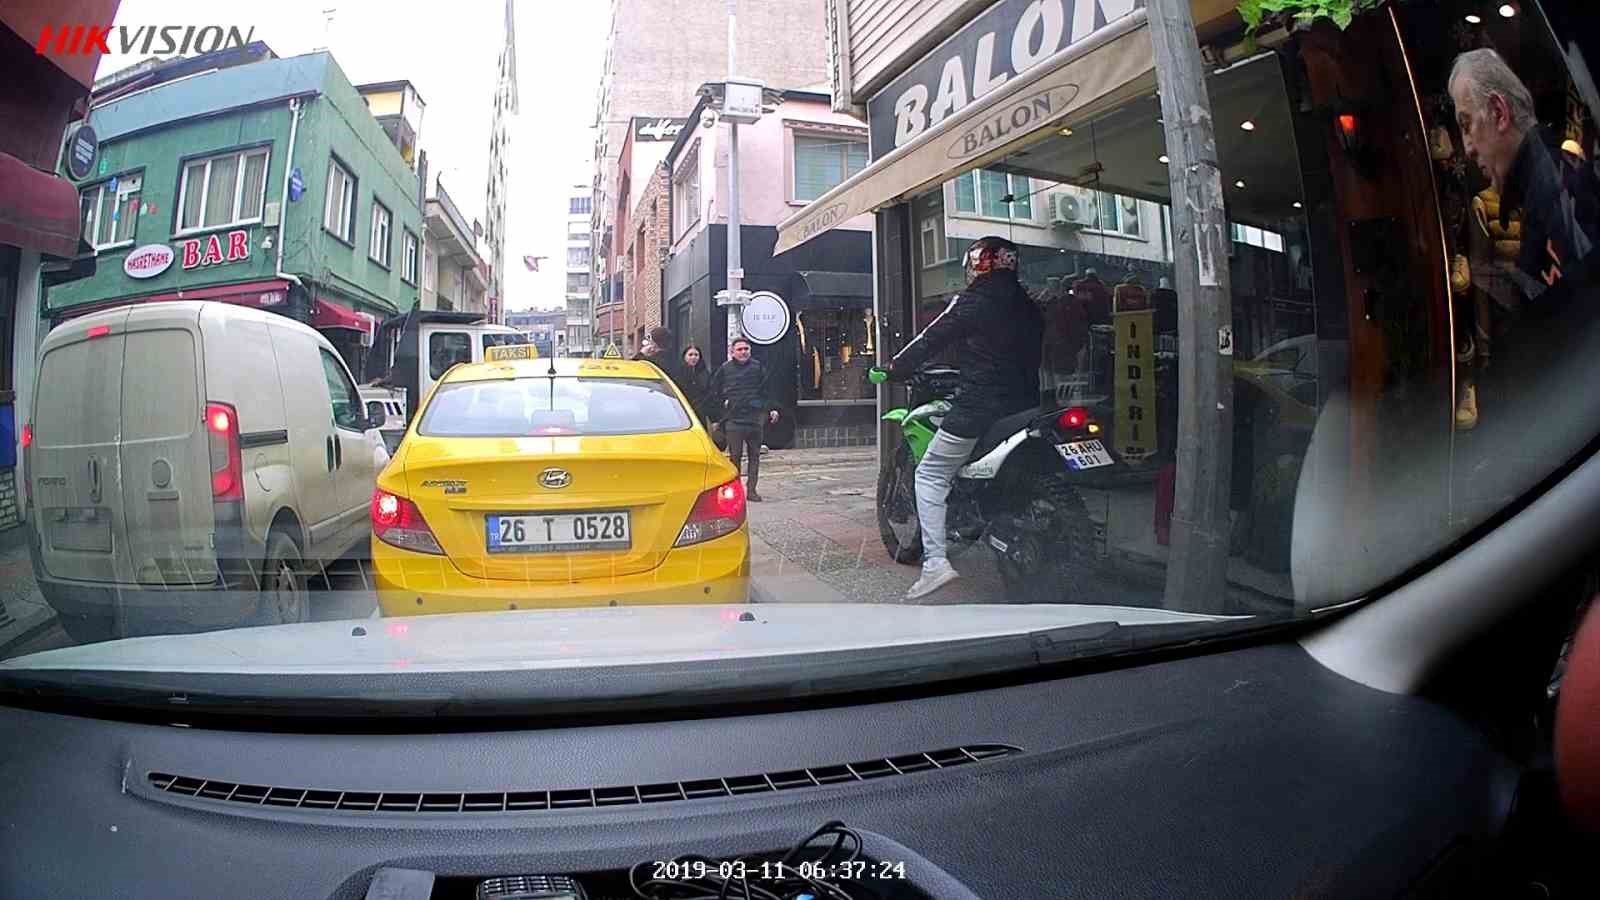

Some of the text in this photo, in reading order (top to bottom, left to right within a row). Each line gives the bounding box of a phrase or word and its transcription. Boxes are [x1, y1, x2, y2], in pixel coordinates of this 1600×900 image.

[963, 93, 1051, 154] BALON
[802, 206, 840, 239] BALON
[183, 230, 248, 269] BAR
[1062, 440, 1102, 456] 26 AHU
[1078, 454, 1101, 466] 601
[500, 515, 625, 542] 26 T 0528
